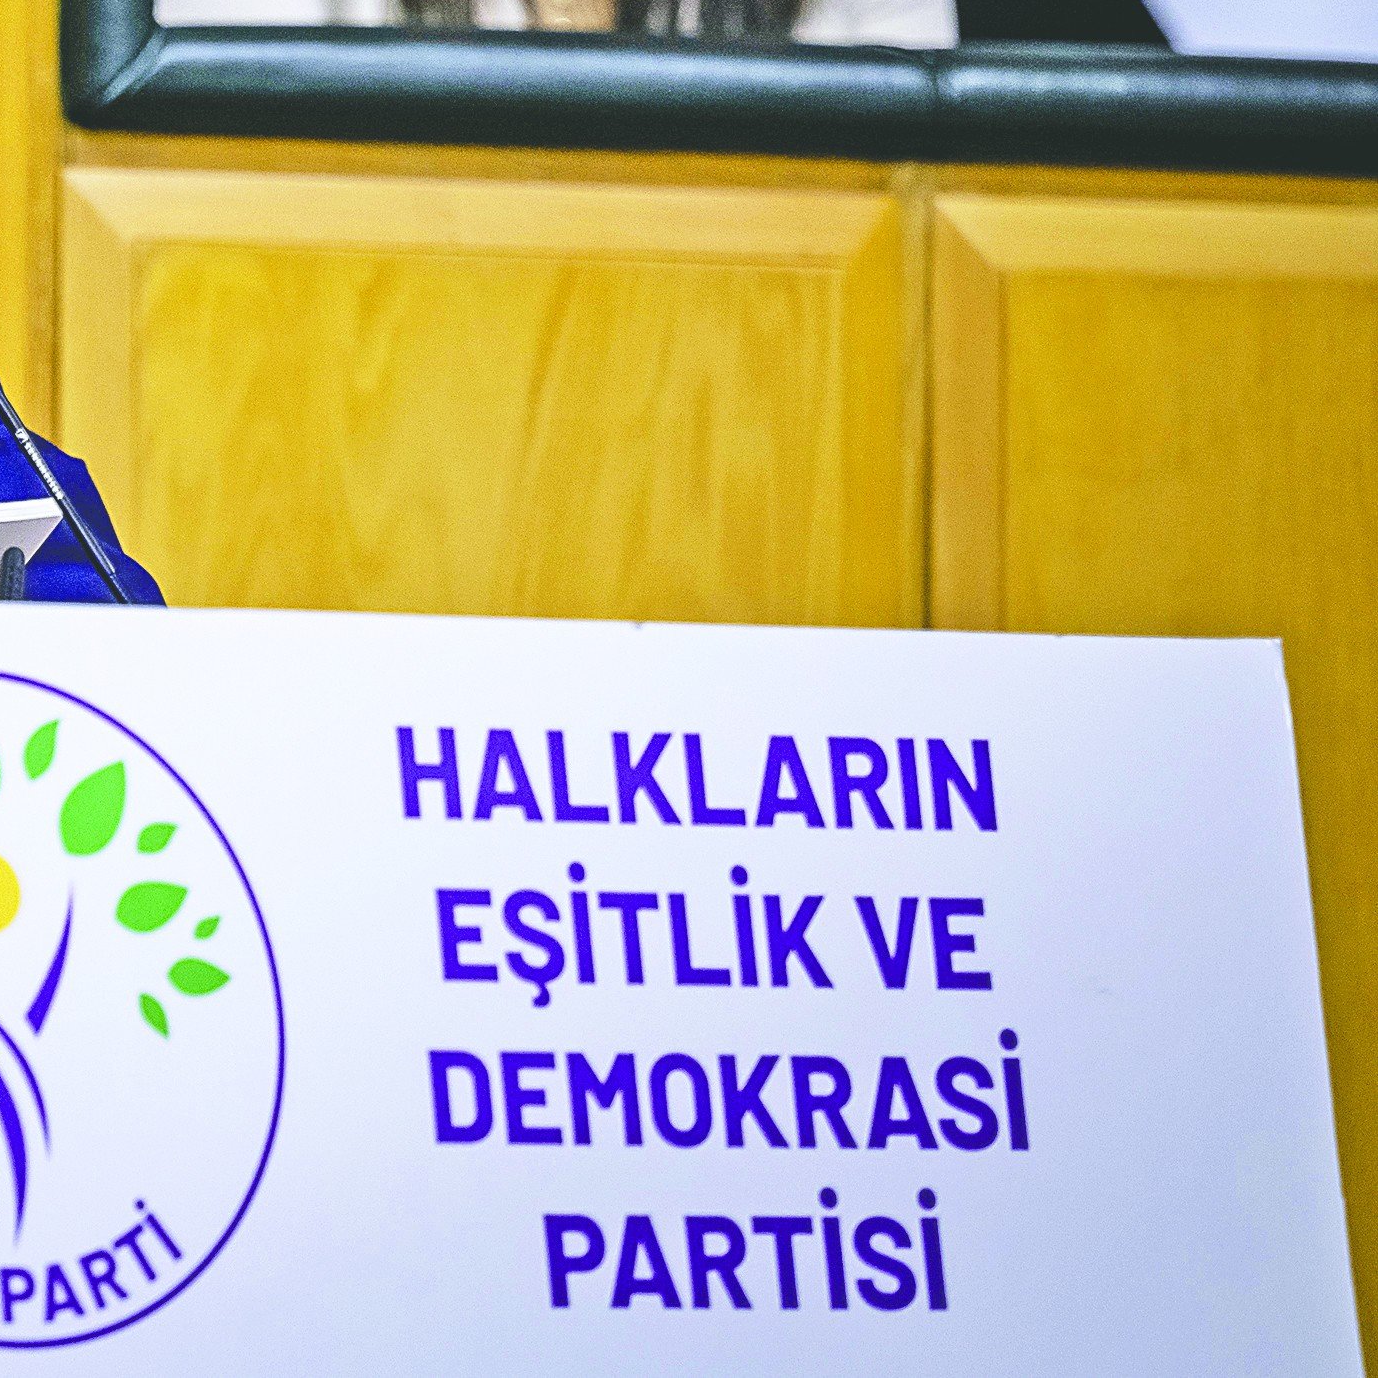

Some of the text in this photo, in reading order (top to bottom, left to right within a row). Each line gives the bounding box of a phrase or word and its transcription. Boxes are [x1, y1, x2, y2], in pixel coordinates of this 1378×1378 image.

[394, 724, 999, 834] HALKLARIN
[434, 860, 994, 1009] EŞİTLİK VE
[426, 1026, 1031, 1153] DEMOKRASİ
[541, 1185, 950, 1313] PARTİSİ
